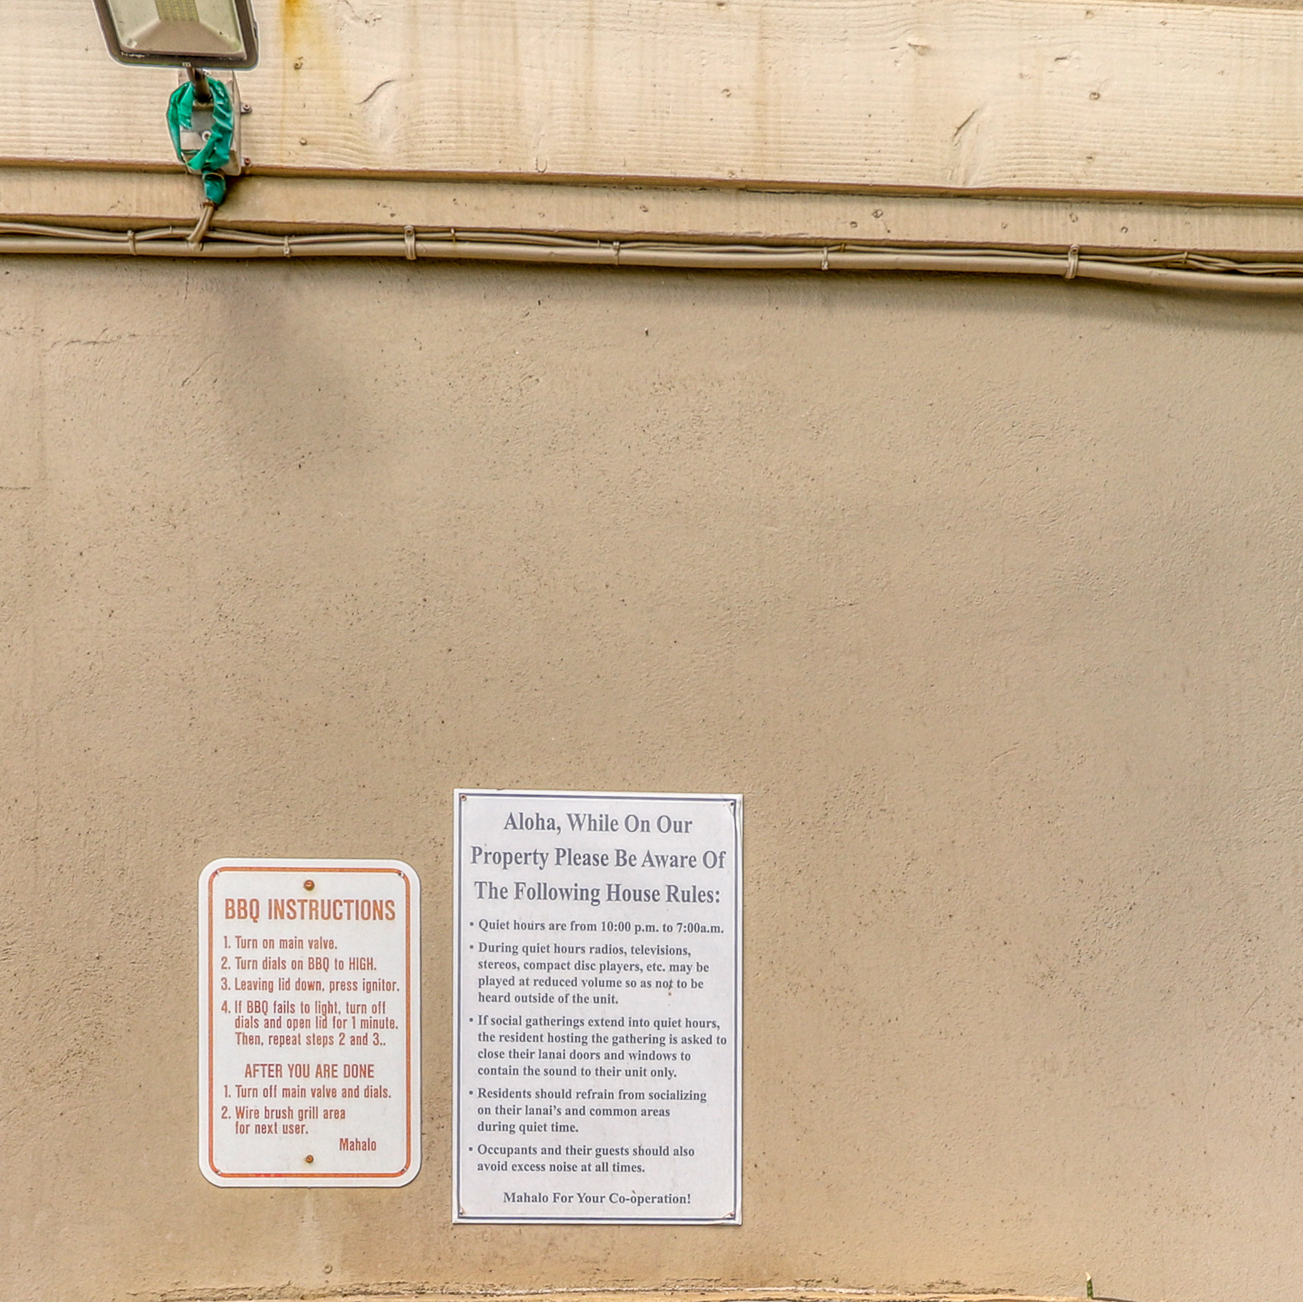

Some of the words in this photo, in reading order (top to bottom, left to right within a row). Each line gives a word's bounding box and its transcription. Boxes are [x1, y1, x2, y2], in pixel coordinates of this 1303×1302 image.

[503, 812, 561, 835] Aloha,
[566, 813, 619, 832] While
[624, 814, 651, 833] On
[657, 815, 693, 833] Our
[471, 846, 549, 871] Property
[554, 848, 609, 867] Please
[614, 849, 637, 867] Be
[641, 850, 697, 868] Aware
[703, 850, 726, 869] Of
[474, 881, 508, 900] The
[514, 882, 601, 907] Following
[606, 883, 660, 902] House
[665, 884, 720, 903] Rules:
[225, 898, 260, 923] BBQ
[268, 899, 396, 921] INSTRUCTIONS
[478, 919, 510, 932] Quiet
[513, 920, 545, 931] hours
[549, 923, 567, 931] are
[570, 920, 597, 931] from
[602, 921, 631, 932] 10:00
[634, 924, 659, 935] p.m.
[662, 923, 673, 933] to
[223, 935, 231, 949] 1.
[235, 935, 258, 949] Turn
[262, 939, 275, 949] on
[279, 936, 304, 949] main
[308, 936, 338, 950] valve.
[479, 942, 519, 956] During
[522, 943, 550, 956] quiet
[554, 943, 586, 954] hours
[589, 944, 627, 956] radios,
[631, 944, 691, 957] televisions,
[221, 956, 231, 970] 2.
[235, 956, 258, 970] Turn
[262, 956, 287, 970] dials
[291, 960, 303, 970] on
[308, 957, 330, 973] BBQ
[334, 958, 344, 970] to
[349, 957, 377, 971] HIGH.
[478, 960, 520, 971] stereos,
[523, 961, 571, 973] compact
[574, 960, 596, 971] disc
[599, 960, 643, 974] players,
[646, 962, 665, 972] etc.
[669, 964, 693, 975] may
[696, 962, 709, 972] be
[221, 977, 231, 991] 3.
[235, 977, 274, 993] Leaving
[278, 977, 291, 991] lid
[295, 977, 325, 992] down,
[329, 981, 358, 993] press
[362, 978, 400, 994] ignitor.
[478, 992, 510, 1003] heard
[514, 993, 555, 1003] outside
[558, 993, 570, 1004] of
[572, 993, 590, 1004] the
[593, 994, 618, 1004] unit.
[221, 1000, 231, 1014] 4.
[235, 1000, 242, 1013] If
[247, 1000, 268, 1016] BBQ
[273, 1000, 296, 1014] fails
[300, 1001, 310, 1014] to
[315, 1000, 341, 1016] light,
[346, 1001, 367, 1014] turn
[371, 1001, 386, 1014] off
[235, 1015, 259, 1029] dials
[264, 1015, 282, 1029] and
[286, 1018, 311, 1031] open
[315, 1016, 327, 1029] lid
[332, 1016, 348, 1029] for
[360, 1016, 398, 1029] minute.
[478, 1015, 489, 1025] If
[491, 1015, 522, 1026] social
[525, 1016, 585, 1029] gatherings
[588, 1017, 625, 1027] extend
[628, 1017, 650, 1027] into
[653, 1017, 681, 1030] quiet
[685, 1018, 720, 1030] hours,
[235, 1032, 264, 1046] Then,
[268, 1033, 301, 1048] repeat
[306, 1033, 334, 1048] steps
[339, 1032, 346, 1046] 2
[350, 1032, 368, 1046] and
[477, 1048, 505, 1059] close
[508, 1048, 535, 1059] their
[538, 1049, 566, 1059] lanai
[569, 1049, 601, 1060] doors
[604, 1050, 625, 1060] and
[628, 1050, 677, 1061] windows
[680, 1052, 691, 1061] to
[244, 1063, 283, 1078] AFTER
[287, 1063, 310, 1078] YOU
[315, 1064, 338, 1078] ARE
[343, 1063, 374, 1078] DONE
[224, 1084, 231, 1098] 1.
[235, 1084, 258, 1098] Turn
[263, 1084, 277, 1098] off
[282, 1085, 306, 1098] main
[310, 1085, 337, 1098] valve
[341, 1085, 360, 1098] and
[364, 1085, 391, 1098] dials.
[478, 1088, 532, 1099] Residents
[535, 1088, 572, 1099] should
[576, 1089, 614, 1099] refrain
[618, 1089, 645, 1100] from
[648, 1089, 707, 1103] socializing
[221, 1106, 231, 1119] 2.
[235, 1106, 260, 1119] Wire
[264, 1106, 294, 1119] brush
[298, 1106, 318, 1122] grill
[323, 1109, 346, 1120] area
[477, 1107, 491, 1115] on
[495, 1104, 522, 1115] their
[525, 1105, 562, 1116] lanai's
[565, 1105, 586, 1116] and
[589, 1108, 637, 1116] common
[641, 1109, 670, 1117] areas
[235, 1121, 250, 1134] for
[255, 1122, 278, 1134] next
[282, 1124, 308, 1135] user.
[477, 1121, 516, 1135] during
[519, 1121, 547, 1135] quiet
[551, 1121, 579, 1133] time.
[339, 1137, 377, 1151] Mahalo
[477, 1144, 537, 1158] Occupants
[541, 1145, 562, 1155] and
[565, 1145, 592, 1155] their
[595, 1146, 629, 1158] guests
[633, 1145, 669, 1156] should
[673, 1146, 695, 1157] also
[477, 1161, 508, 1171] avoid
[511, 1164, 546, 1172] excess
[549, 1161, 578, 1172] noise
[581, 1163, 592, 1172] at
[595, 1162, 609, 1172] all
[612, 1162, 645, 1173] times.
[503, 1192, 549, 1203] Mahalo
[553, 1192, 574, 1203] For
[576, 1192, 606, 1203] Your
[609, 1192, 691, 1206] Co-operation!
